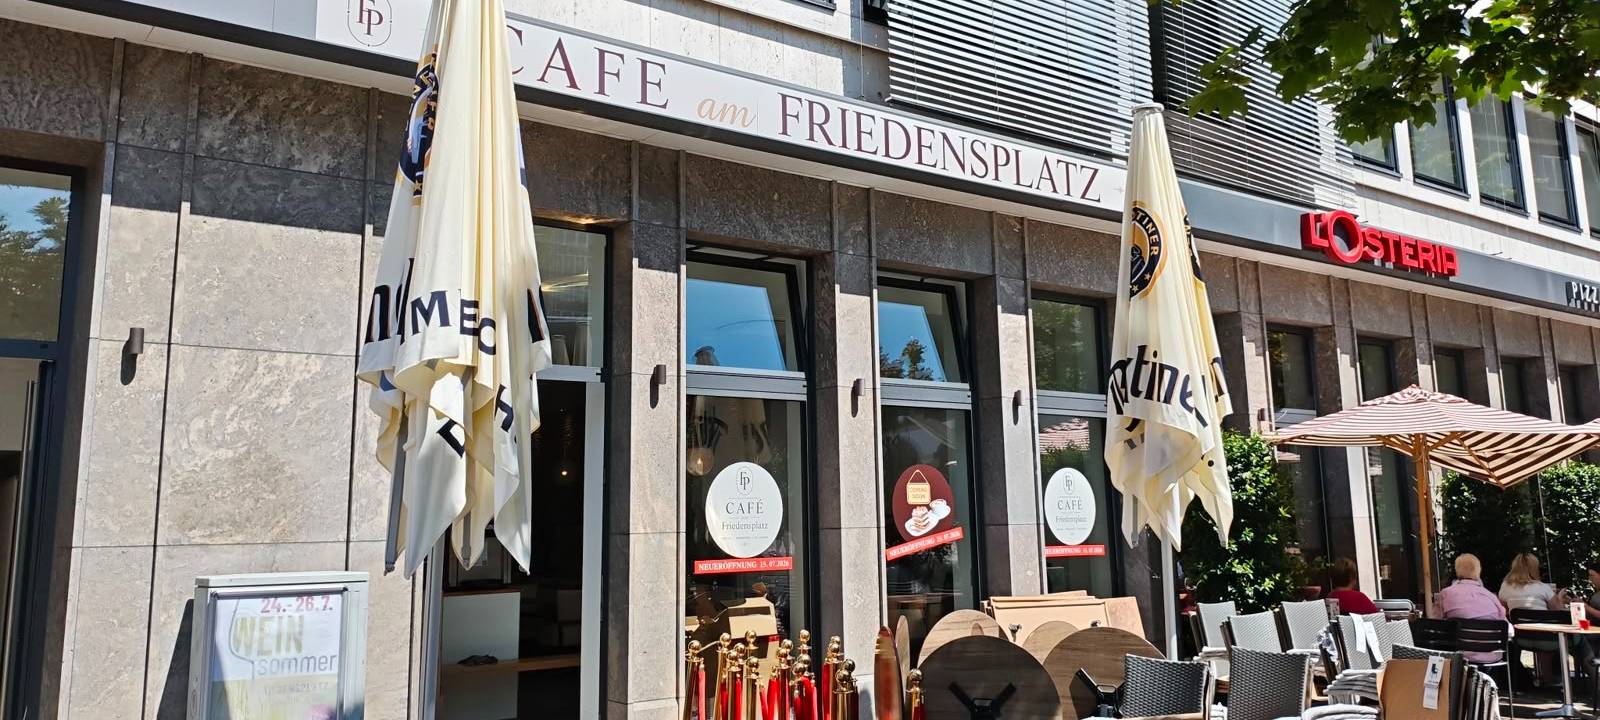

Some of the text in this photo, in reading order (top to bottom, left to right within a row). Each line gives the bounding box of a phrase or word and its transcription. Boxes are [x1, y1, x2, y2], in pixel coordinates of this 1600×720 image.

[696, 97, 757, 129] am
[777, 92, 1102, 203] FRIEDENSPLATZ
[1132, 208, 1160, 257] TINER
[1570, 281, 1600, 304] PIZZ
[726, 498, 764, 515] CAFÉ
[722, 521, 768, 532] Friedensplatz
[232, 615, 304, 656] WEIN
[257, 654, 337, 676] sommer
